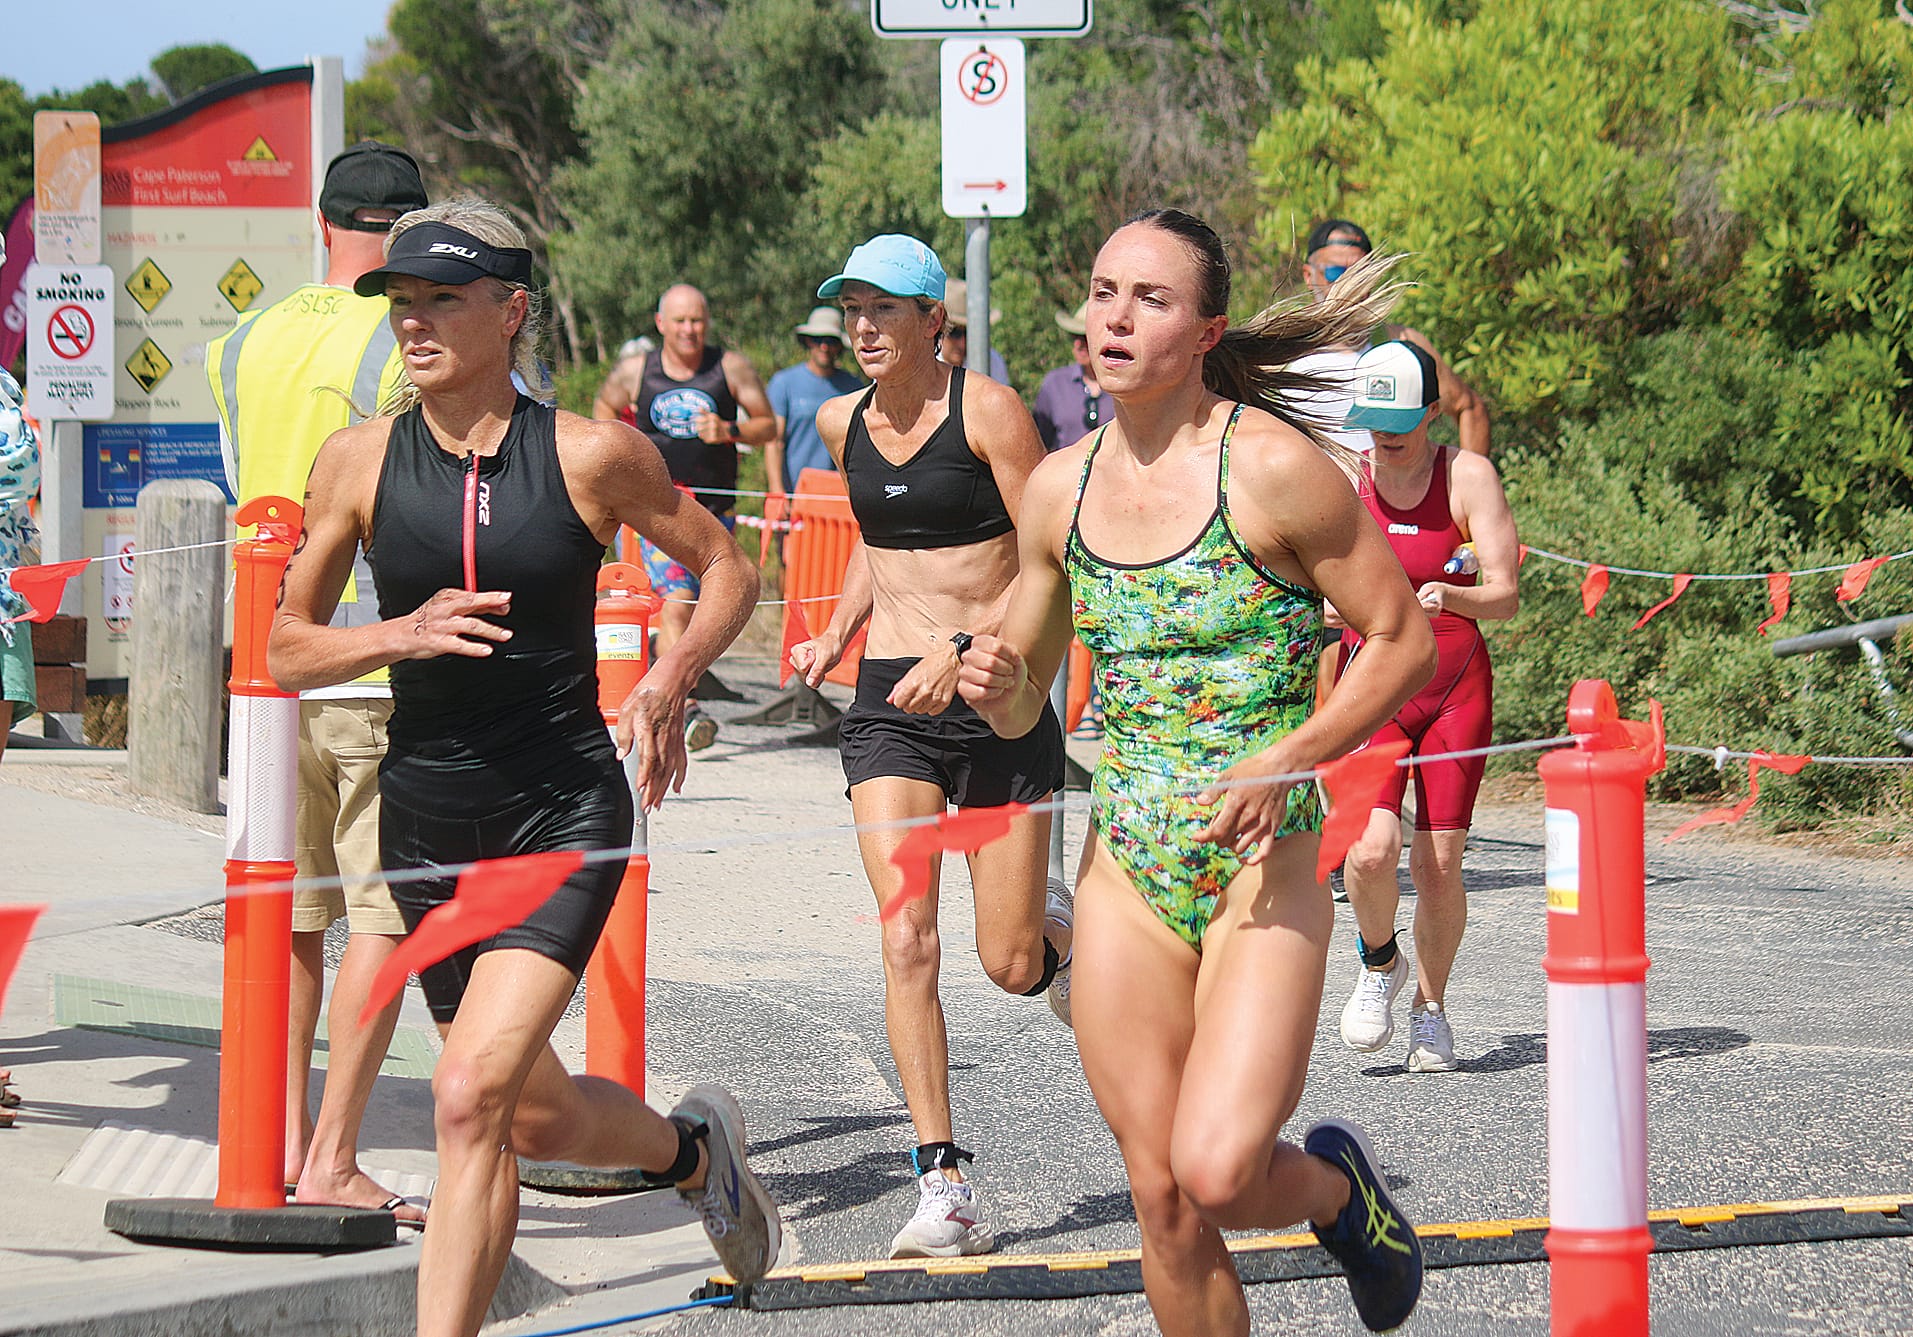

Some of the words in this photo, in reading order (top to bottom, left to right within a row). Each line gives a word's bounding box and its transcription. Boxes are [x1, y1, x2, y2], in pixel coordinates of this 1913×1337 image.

[133, 166, 165, 185] Cape
[167, 166, 222, 184] Paterson
[133, 186, 160, 203] First
[162, 186, 188, 203] Surf
[190, 187, 228, 204] Beach
[60, 273, 82, 285] NO
[36, 288, 105, 301] SMOKING
[884, 484, 908, 493] speedo
[1388, 523, 1419, 535] arena
[608, 652, 634, 660] events
